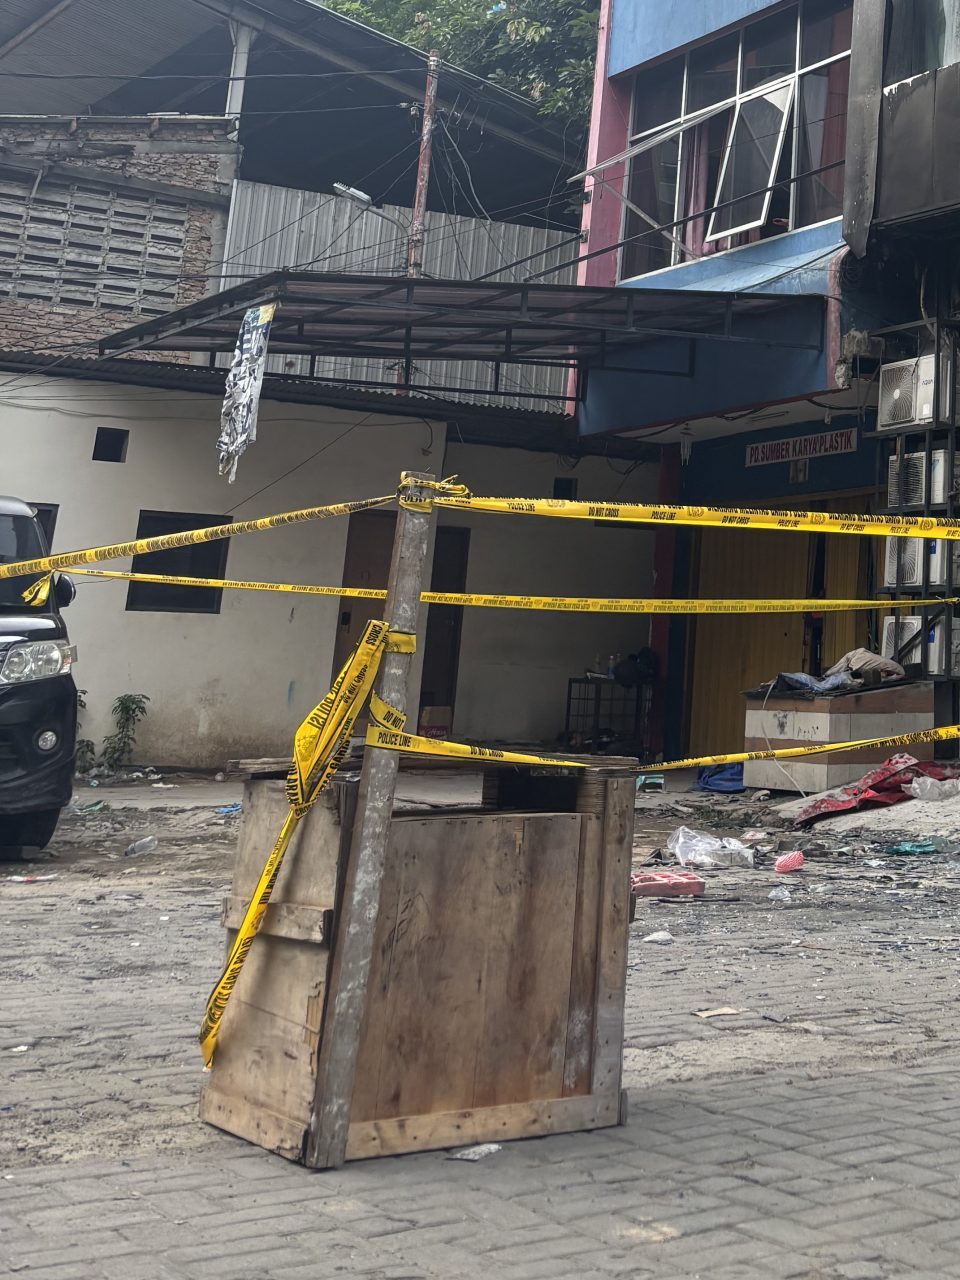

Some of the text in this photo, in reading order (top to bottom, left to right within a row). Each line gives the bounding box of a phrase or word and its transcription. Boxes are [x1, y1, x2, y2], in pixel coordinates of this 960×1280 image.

[761, 442, 790, 462] SUMBER
[792, 437, 817, 457] KARYA
[819, 431, 853, 453] PLASTIK
[366, 624, 383, 646] CROSS
[383, 710, 405, 729] DO NOT
[377, 732, 412, 748] POLICE LINE
